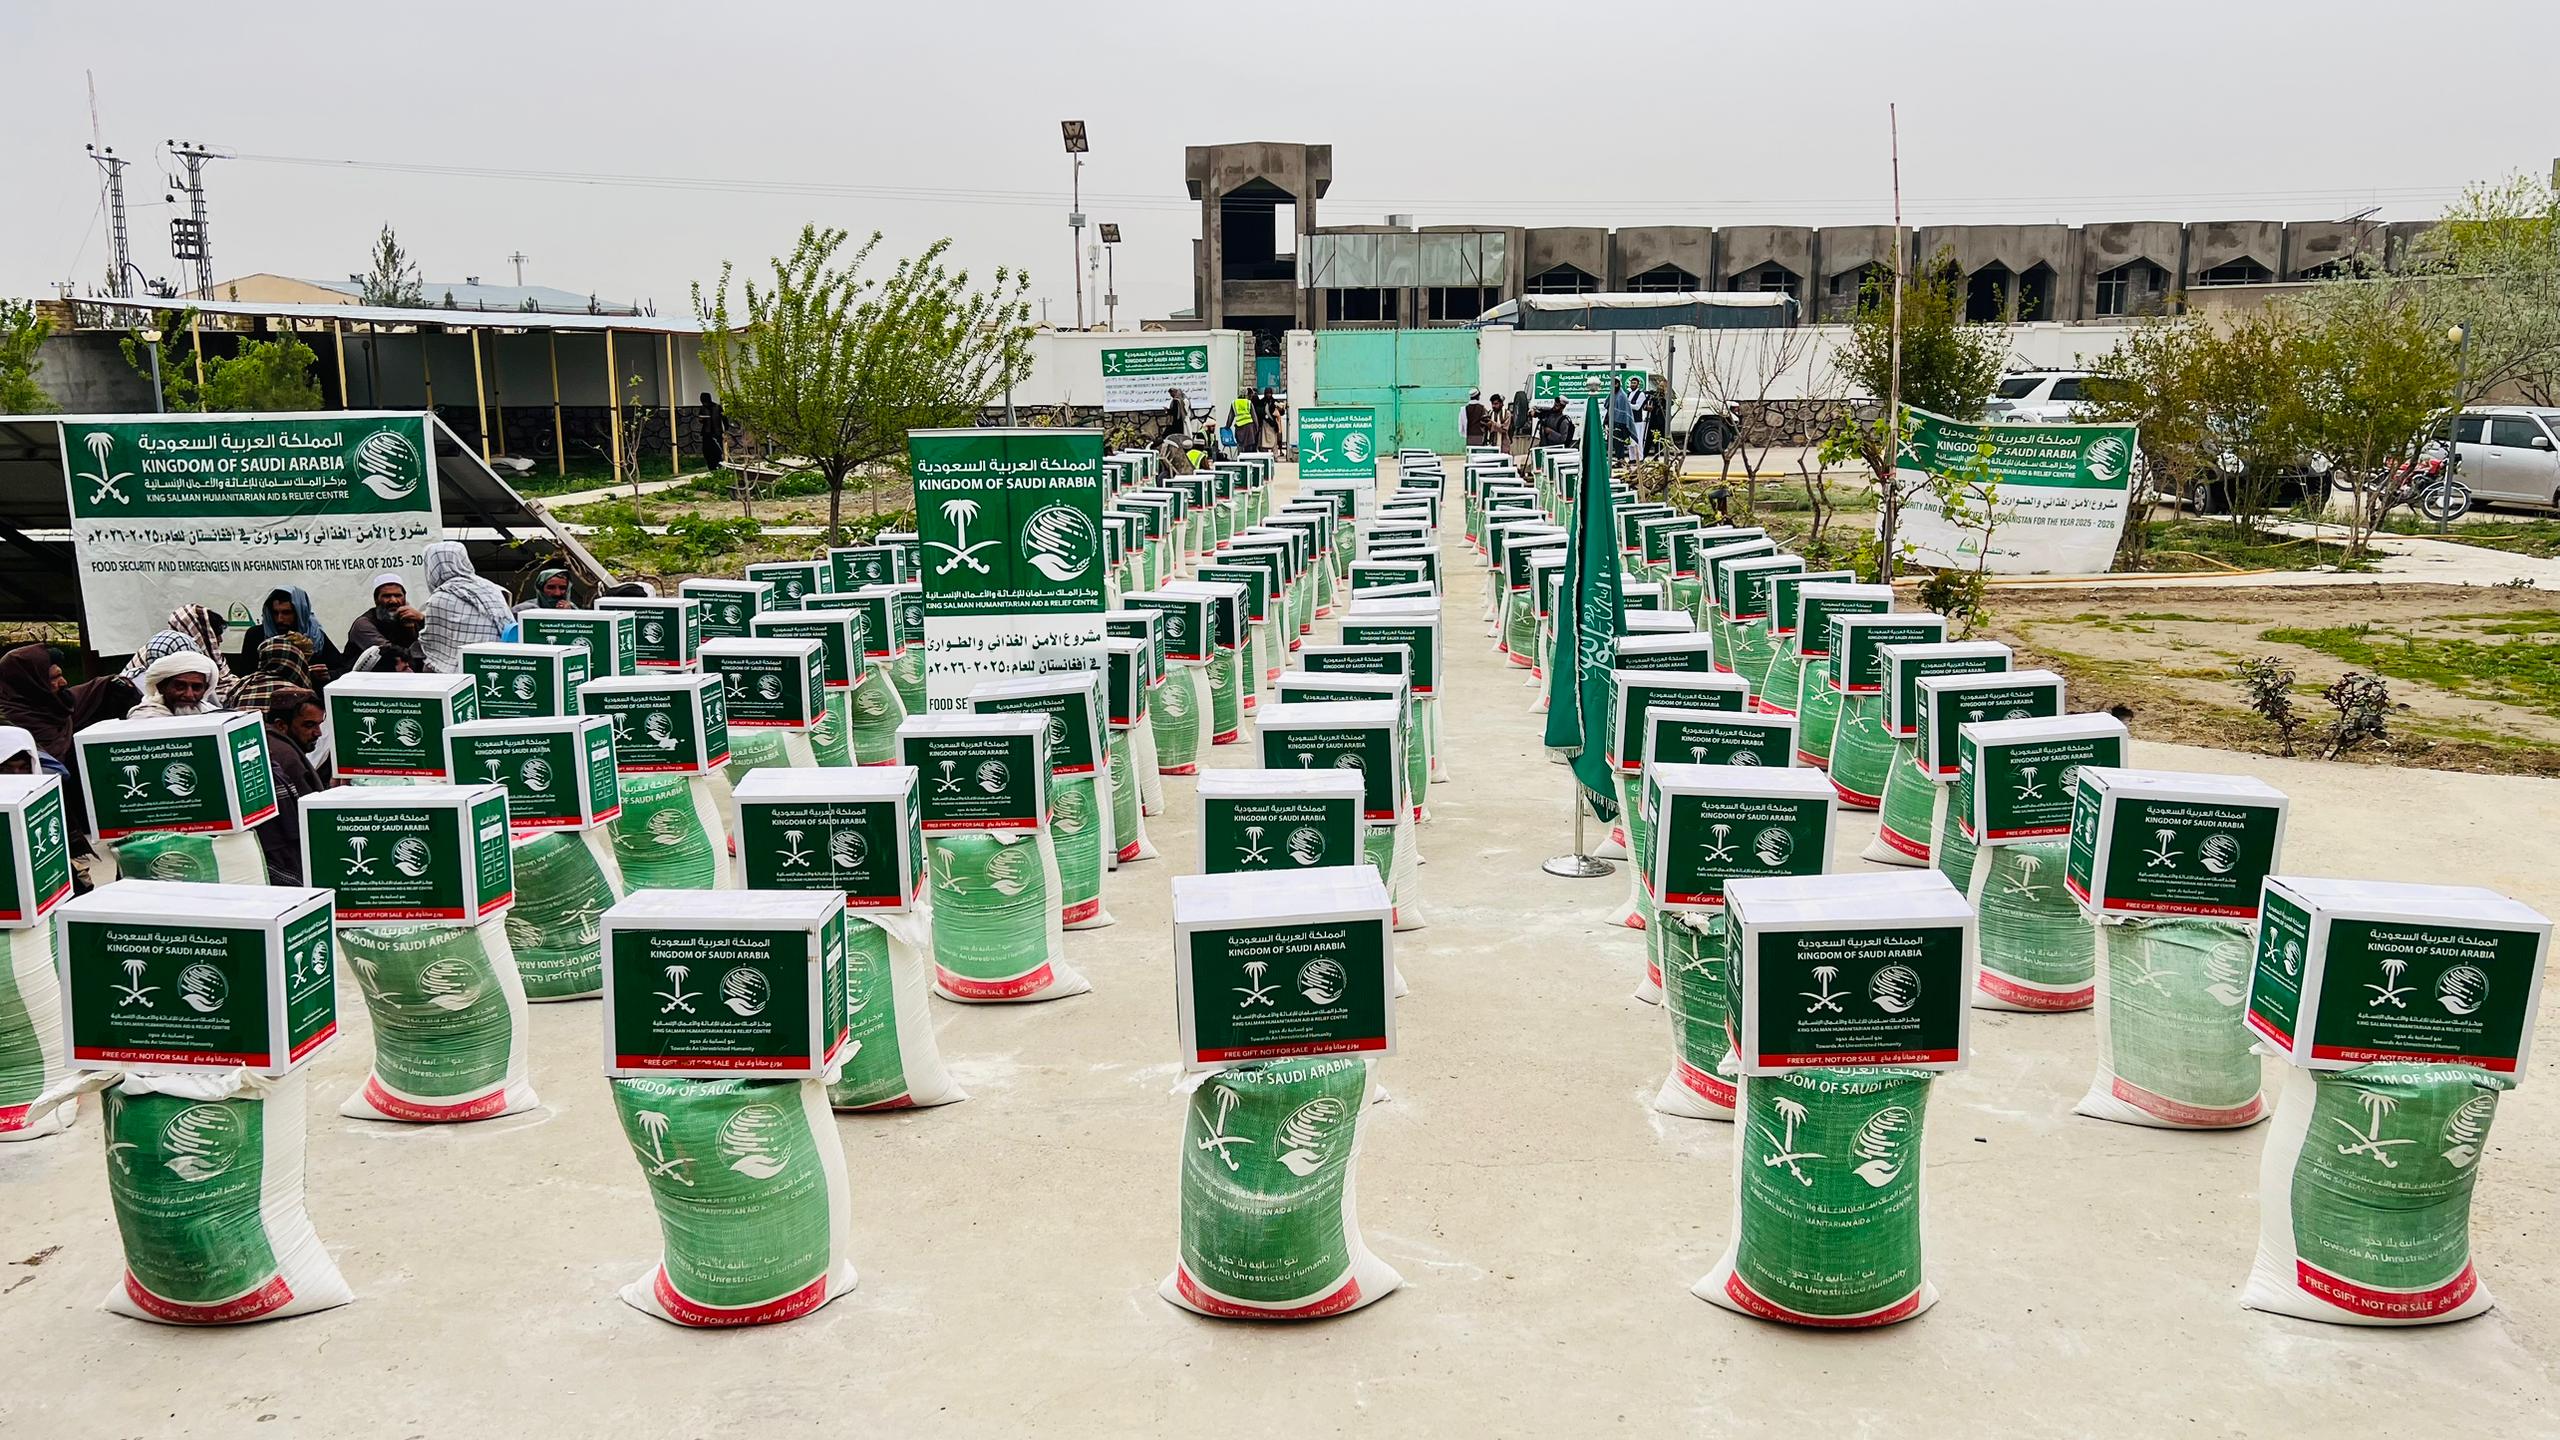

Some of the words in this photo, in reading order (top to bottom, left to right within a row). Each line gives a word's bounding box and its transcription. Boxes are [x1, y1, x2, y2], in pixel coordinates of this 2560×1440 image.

[138, 434, 217, 454] السعودية
[221, 433, 275, 453] العربية
[279, 432, 343, 449] المملكة
[1997, 433, 2035, 446] العربية
[2038, 434, 2081, 445] المملكة
[2005, 447, 2037, 456] SAUDI
[2040, 449, 2076, 458] ARABIA
[142, 459, 214, 473] KINGDOM
[217, 458, 237, 472] OF
[241, 458, 285, 472] SAUDI
[289, 456, 344, 471] ARABIA
[918, 459, 986, 475] السعودية
[989, 459, 1037, 475] العربية
[1040, 458, 1095, 471] المملكة
[1992, 457, 2014, 465] للإغاثة
[2015, 459, 2038, 468] سلمان
[2039, 461, 2058, 469] الملك
[2059, 462, 2076, 471] مركز
[144, 478, 185, 490] الإنسانية
[224, 477, 258, 489] للإغاثة
[258, 477, 292, 488] سلمان
[293, 477, 321, 487] الملك
[322, 476, 347, 487] مركز
[919, 479, 983, 490] KINGDOM
[986, 478, 1003, 489] OF
[1006, 478, 1046, 489] SAUDI
[1049, 477, 1096, 488] ARABIA
[146, 494, 166, 502] KING
[167, 494, 201, 502] SALMAN
[202, 492, 266, 501] HUMANITARIAN
[267, 493, 281, 501] AID
[281, 492, 288, 500] &
[288, 492, 314, 500] RELIEF
[315, 490, 349, 499] CENTRE
[1924, 503, 1937, 513] AND
[2034, 517, 2046, 525] FOR
[2048, 518, 2058, 526] THE
[2059, 518, 2074, 527] YEAR
[2076, 519, 2092, 527] 2025
[2098, 520, 2115, 528] 2026
[189, 527, 236, 546] أفغانستان
[238, 528, 253, 544] في
[253, 527, 310, 545] والطوارئ
[314, 526, 351, 546] الغذائي
[356, 524, 386, 543] الأمن
[388, 521, 428, 541] مشروع
[91, 561, 117, 572] FOOD
[118, 561, 155, 572] SECURITY
[158, 561, 176, 572] AND
[177, 561, 230, 572] EMEGENGIES
[231, 561, 241, 572] IN
[243, 560, 304, 572] AFGHANISTAN
[305, 559, 323, 570] FOR
[324, 559, 341, 570] THE
[341, 558, 366, 570] YEAR
[367, 557, 379, 569] OF
[380, 556, 404, 568] 2025
[411, 555, 423, 566] 20
[926, 591, 961, 600] الإنسانية
[997, 589, 1025, 598] للإغاثة
[1078, 588, 1098, 597] مركز
[927, 636, 983, 652] والطوارئ
[988, 634, 1027, 651] الغذائي
[1032, 632, 1061, 650] الأمن
[1064, 630, 1101, 647] مشروع
[929, 698, 953, 711] FOOD
[955, 697, 969, 710] SE
[650, 937, 696, 948] السعودية
[697, 937, 730, 948] العربية
[732, 938, 770, 947] المملكة
[1798, 939, 1846, 950] السعودية
[1847, 938, 1881, 948] العربية
[1883, 937, 1923, 945] المملكة
[107, 944, 150, 953] KINGDOM
[152, 946, 164, 954] OF
[166, 946, 193, 955] SAUDI
[194, 948, 228, 956] ARABIA
[651, 951, 693, 959] KINGDOM
[694, 951, 707, 959] OF
[708, 951, 735, 959] SAUDI
[737, 951, 770, 959] ARABIA
[1228, 947, 1271, 956] KINGDOM
[1272, 946, 1284, 954] OF
[1286, 944, 1312, 953] SAUDI
[1313, 942, 1346, 951] ARABIA
[1797, 951, 1842, 960] KINGDOM
[1844, 951, 1856, 959] OF
[1858, 950, 1886, 958] SAUDI
[1888, 949, 1922, 957] ARABIA
[2368, 943, 2414, 953] KINGDOM
[2415, 946, 2428, 954] OF
[2430, 947, 2459, 956] SAUDI
[2460, 949, 2495, 959] ARABIA
[2305, 1275, 2331, 1294] FREE
[2361, 1298, 2385, 1311] NOT
[2387, 1303, 2407, 1313] FOR
[2410, 1301, 2433, 1313] SALE
